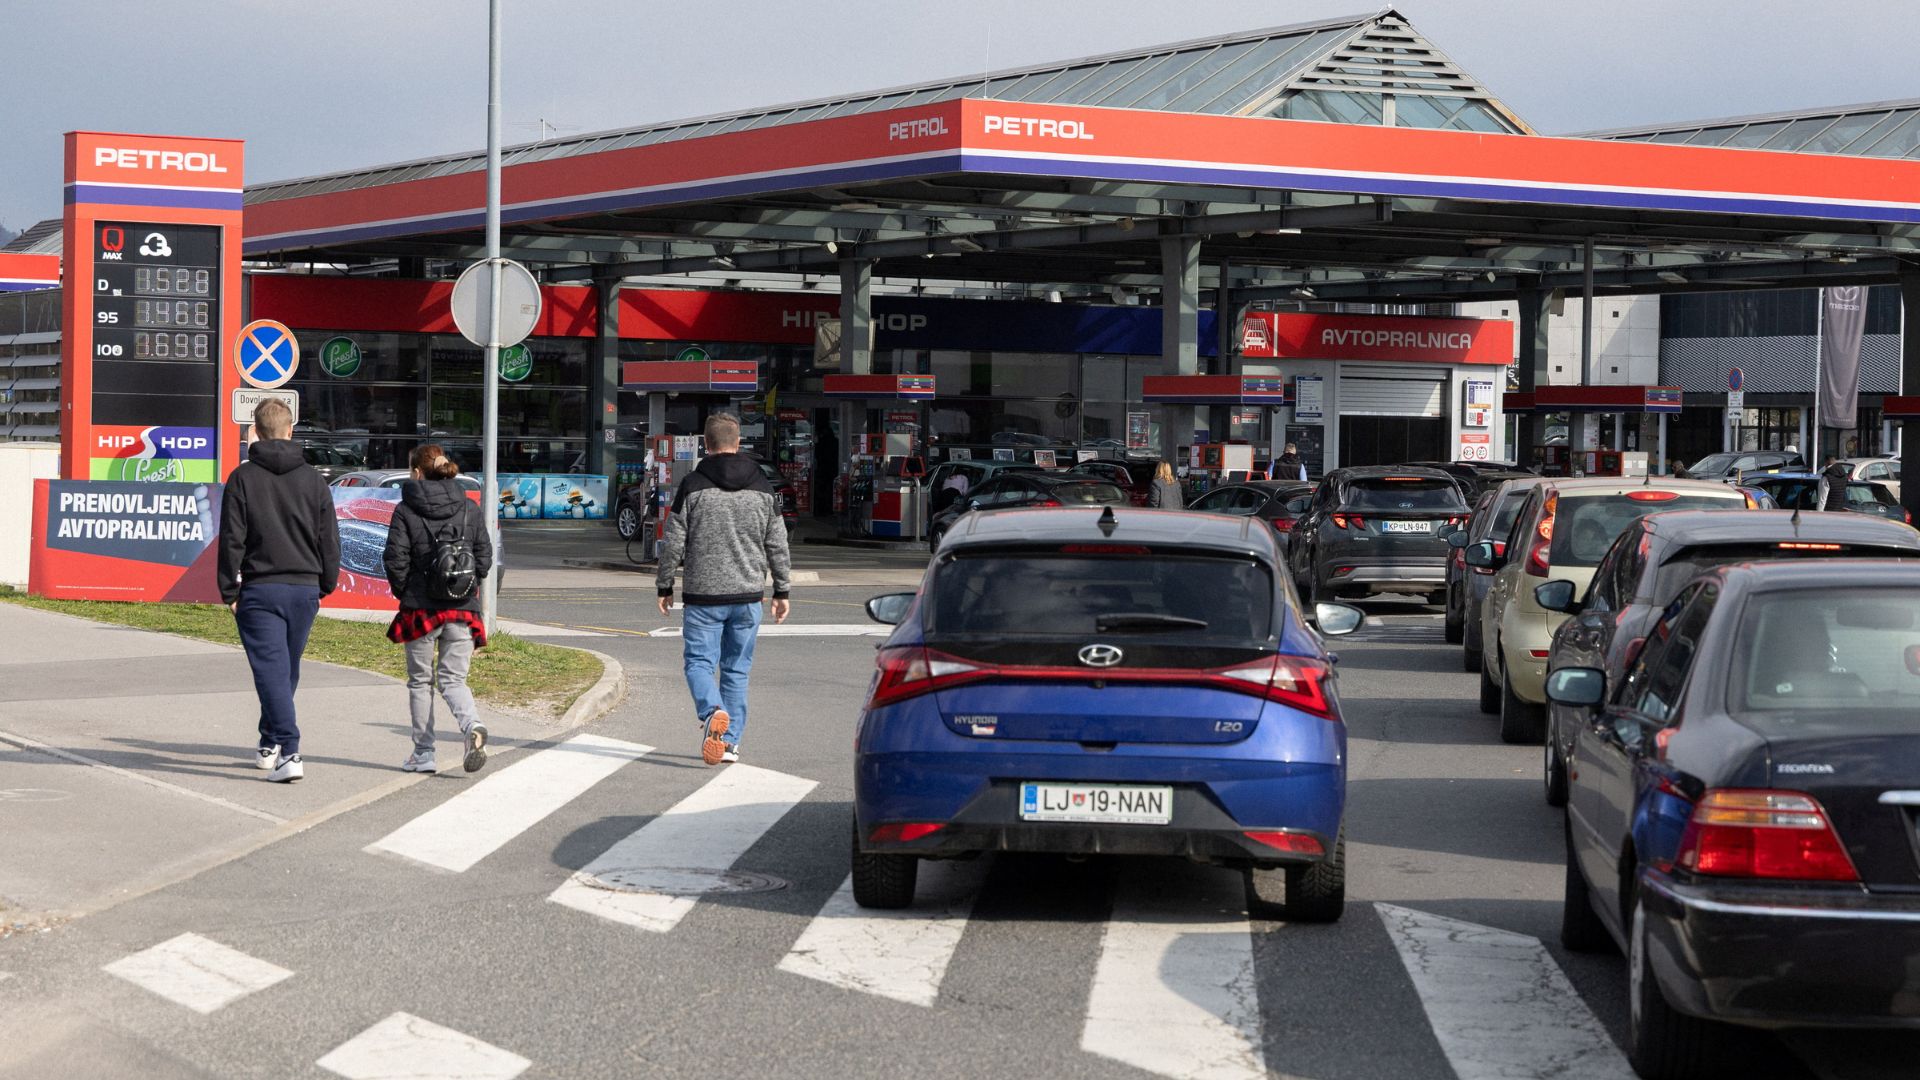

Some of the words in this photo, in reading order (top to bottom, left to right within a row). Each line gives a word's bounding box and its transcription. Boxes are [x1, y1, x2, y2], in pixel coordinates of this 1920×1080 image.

[889, 116, 948, 141] PETROL
[984, 115, 1094, 140] PETROL
[95, 147, 228, 173] PETROL
[102, 252, 122, 261] MAX
[97, 279, 109, 291] D
[97, 311, 119, 324] 95
[1321, 327, 1472, 349] AVTOPRALNICA
[97, 344, 123, 356] 100
[98, 435, 136, 448] HIP
[59, 492, 199, 516] PRENOVLJENA
[57, 518, 204, 541] AVTOPRALNICA
[1388, 522, 1400, 530] KP
[1403, 522, 1428, 531] LN-947
[954, 715, 998, 725] HYUNDAI
[1777, 763, 1835, 774] HONDA
[1043, 788, 1069, 811] LJ
[1089, 789, 1163, 814] 19-NAN
